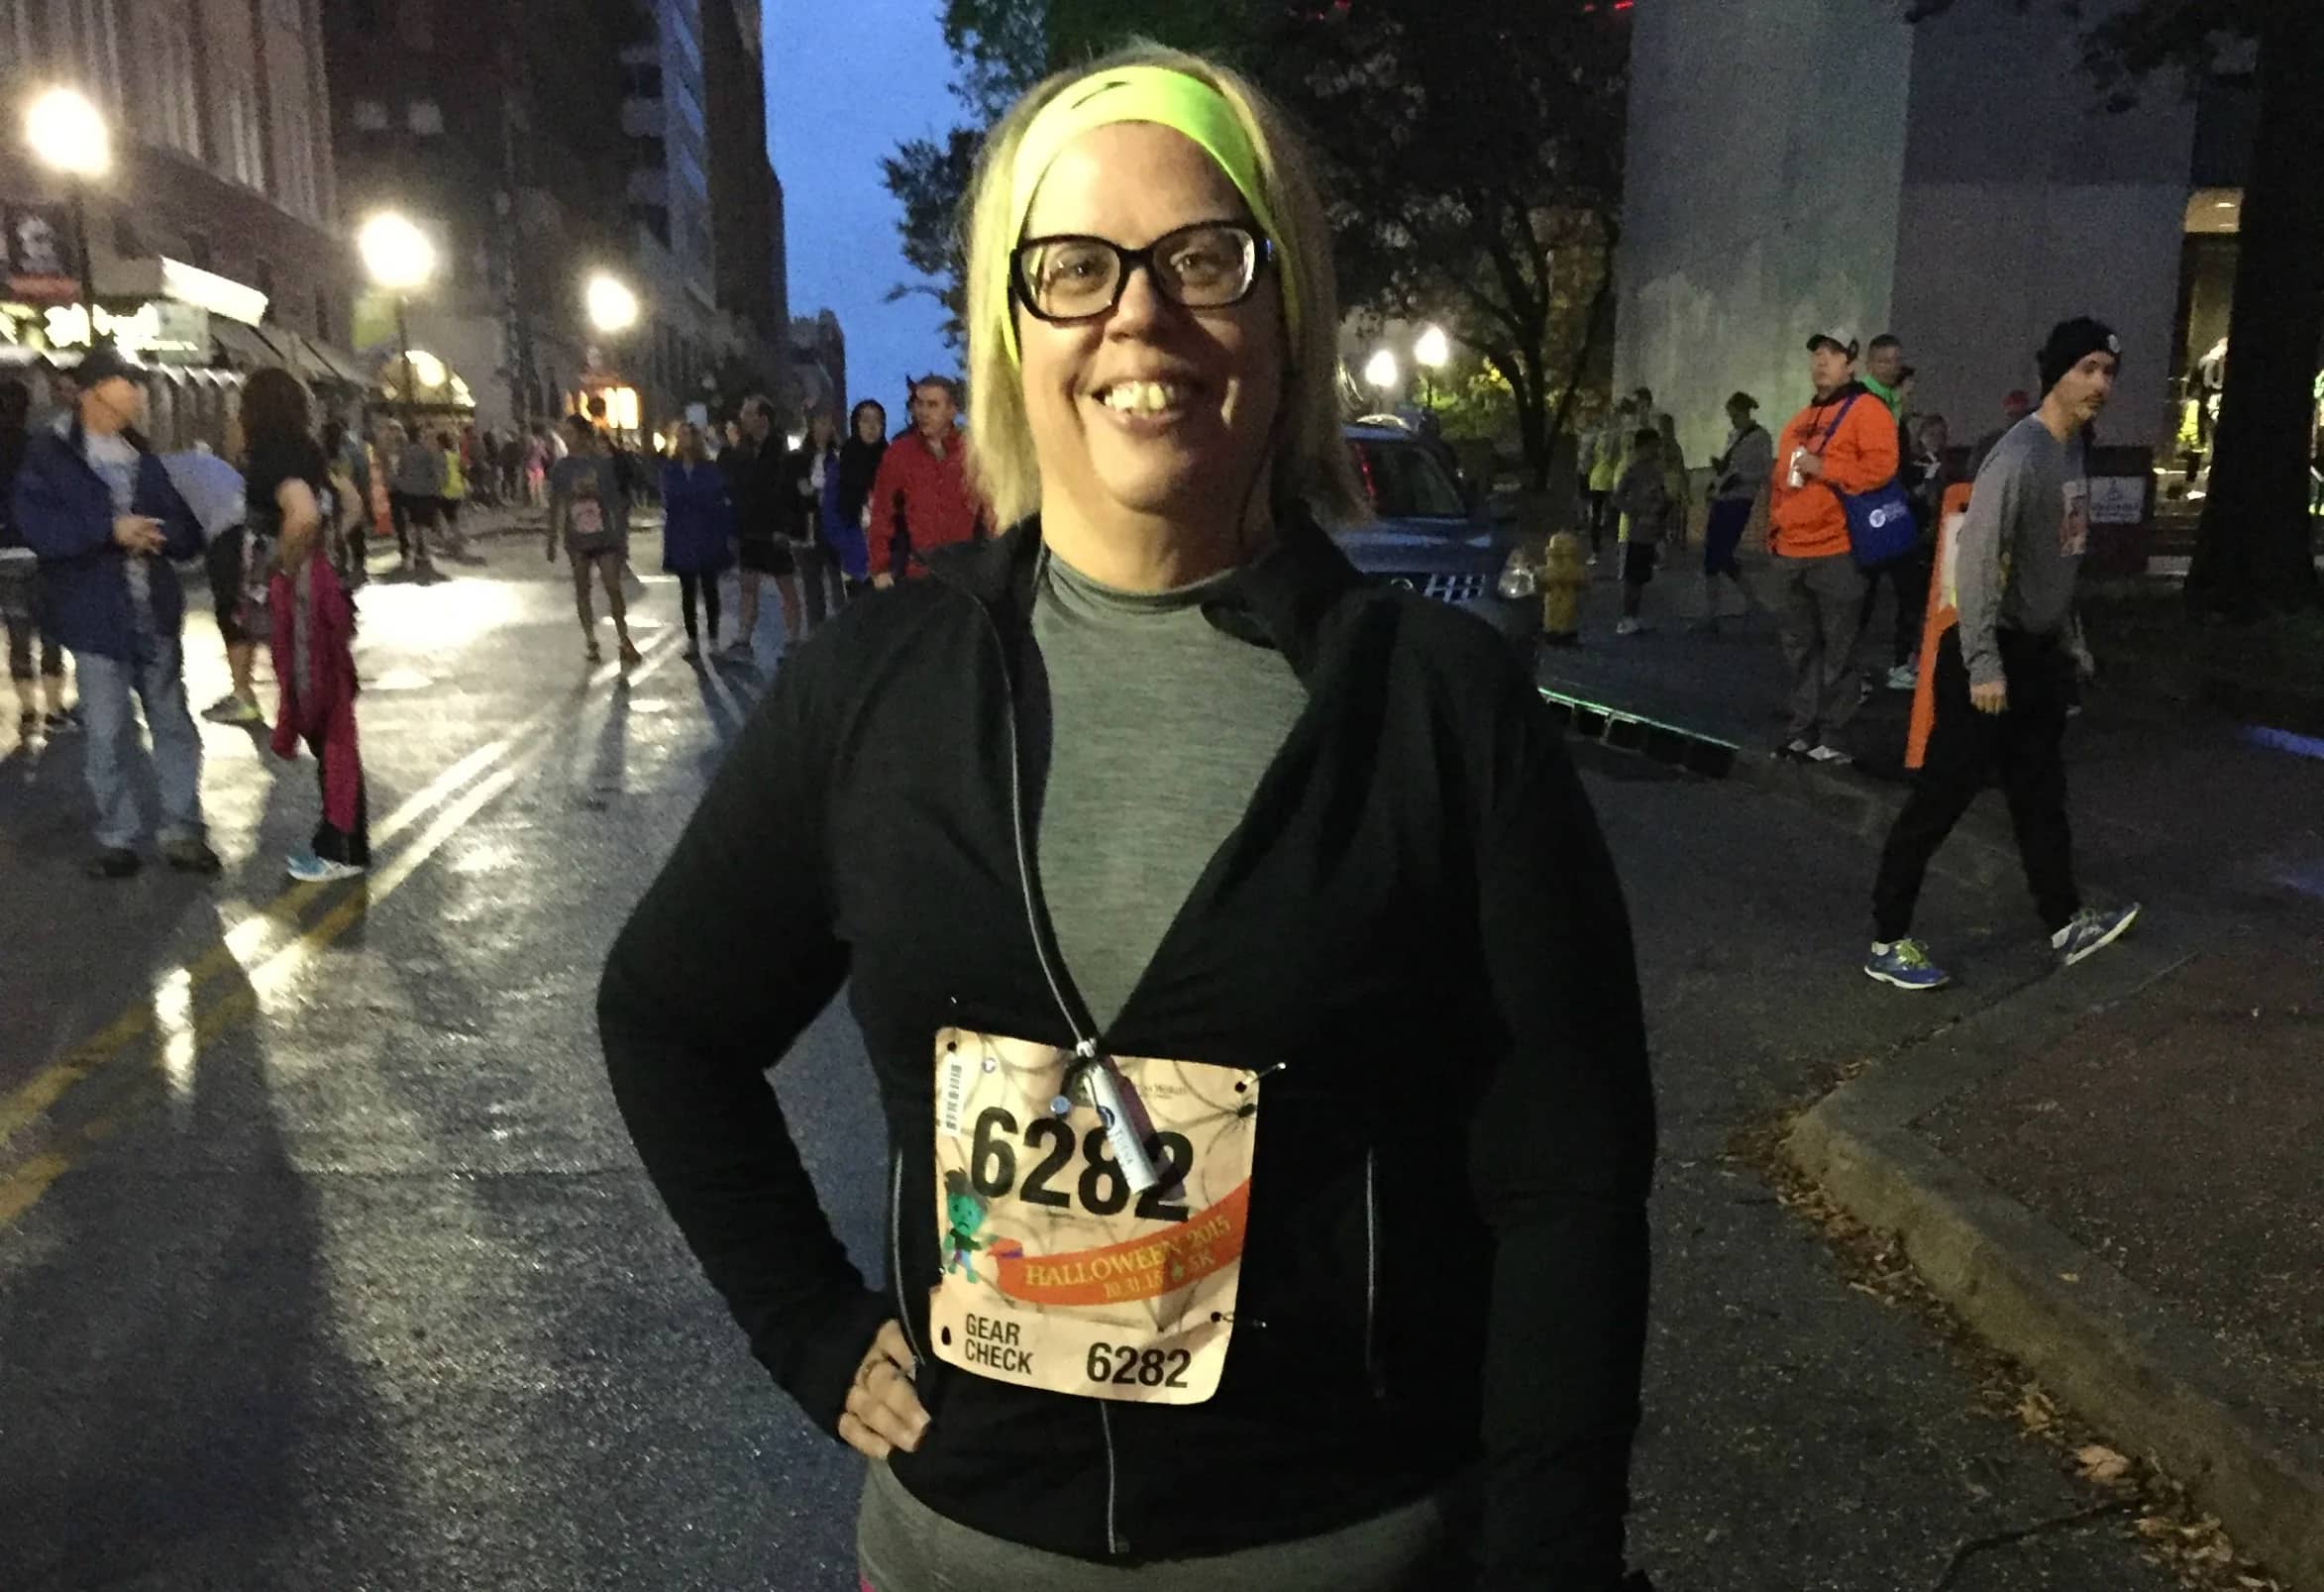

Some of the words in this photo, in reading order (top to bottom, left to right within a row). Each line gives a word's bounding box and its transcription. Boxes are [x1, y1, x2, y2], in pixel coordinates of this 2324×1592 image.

[973, 1107, 1193, 1221] 6282
[1025, 1240, 1181, 1286] HALLOWEEN
[1186, 1215, 1230, 1246] 2015
[966, 1314, 1020, 1345] GEAR
[965, 1339, 1033, 1375] CHECK
[1087, 1341, 1192, 1388] 6282
